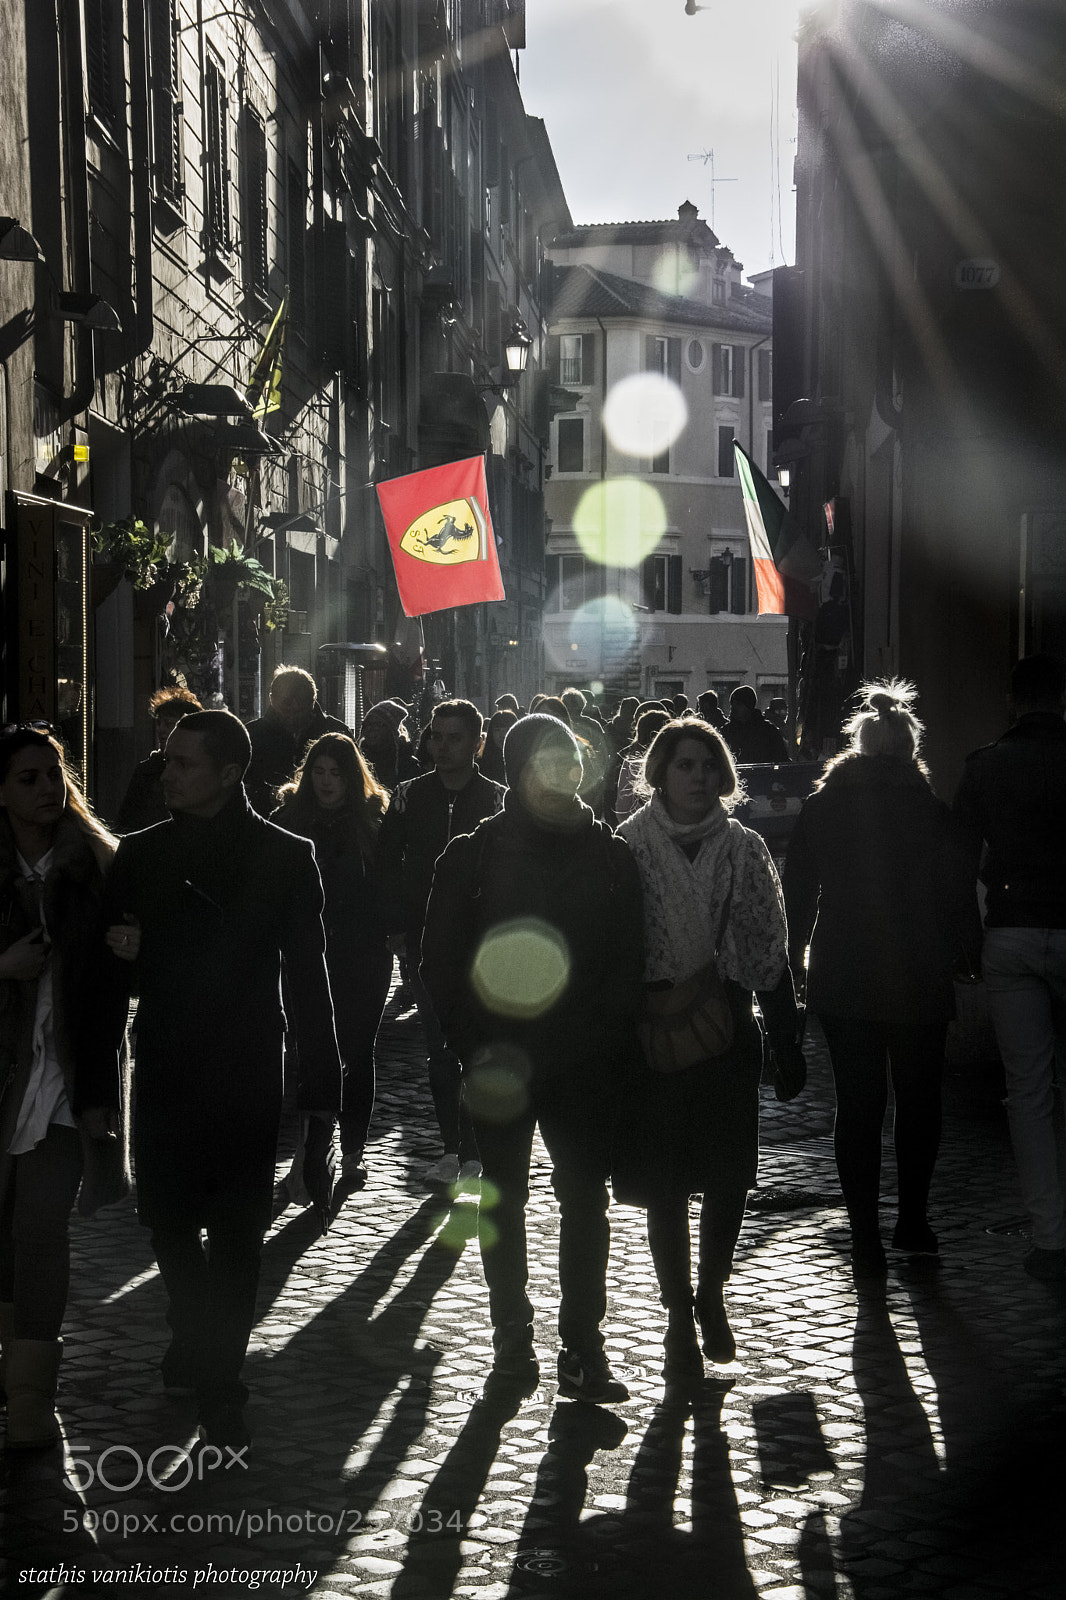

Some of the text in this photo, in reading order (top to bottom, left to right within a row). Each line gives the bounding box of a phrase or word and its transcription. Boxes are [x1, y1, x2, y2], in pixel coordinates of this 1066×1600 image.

[960, 266, 996, 283] 1077
[27, 520, 45, 600] VINI
[28, 619, 45, 637] E
